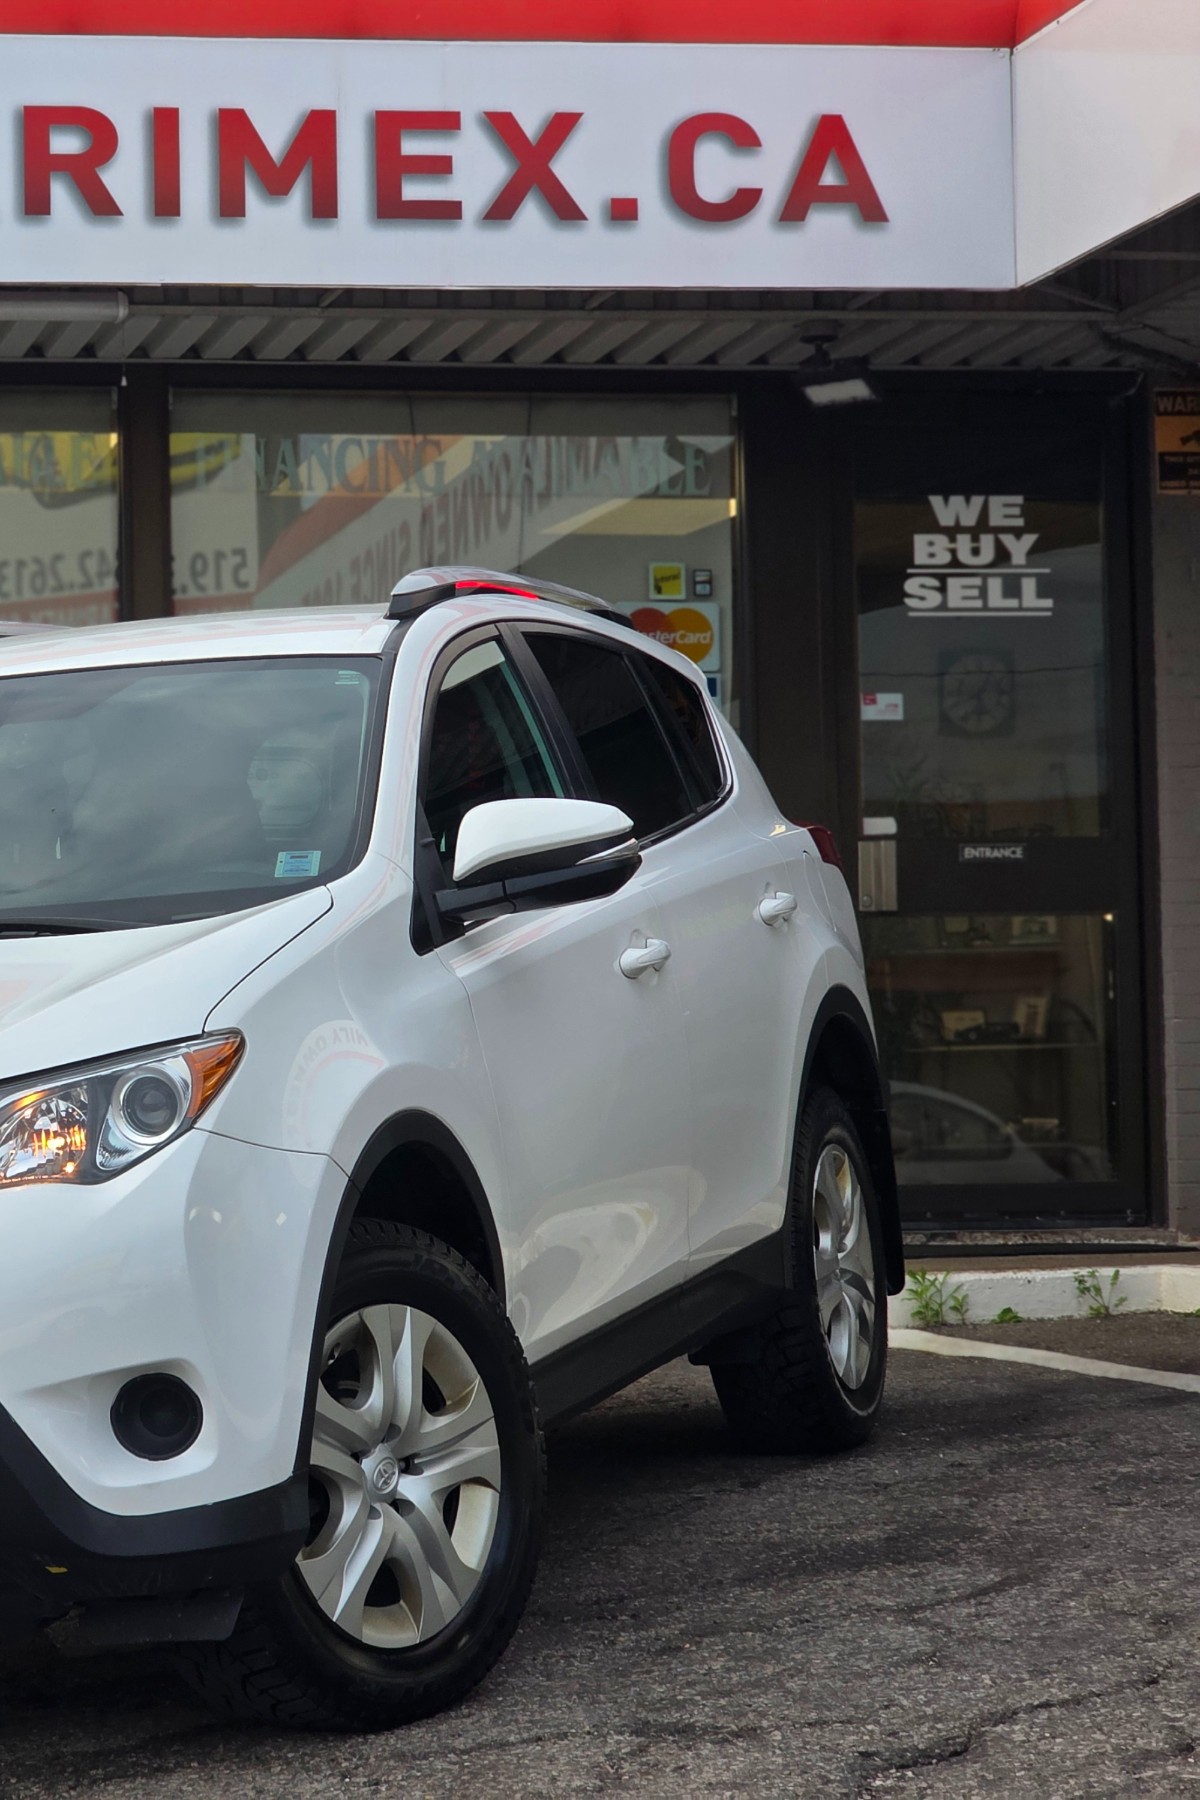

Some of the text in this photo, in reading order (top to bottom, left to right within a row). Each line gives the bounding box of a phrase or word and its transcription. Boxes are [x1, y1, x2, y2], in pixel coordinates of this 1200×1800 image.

[928, 495, 1024, 527] WE
[913, 534, 1039, 566] BUY
[903, 577, 1053, 609] SELL
[963, 846, 1023, 859] ENTRANCE
